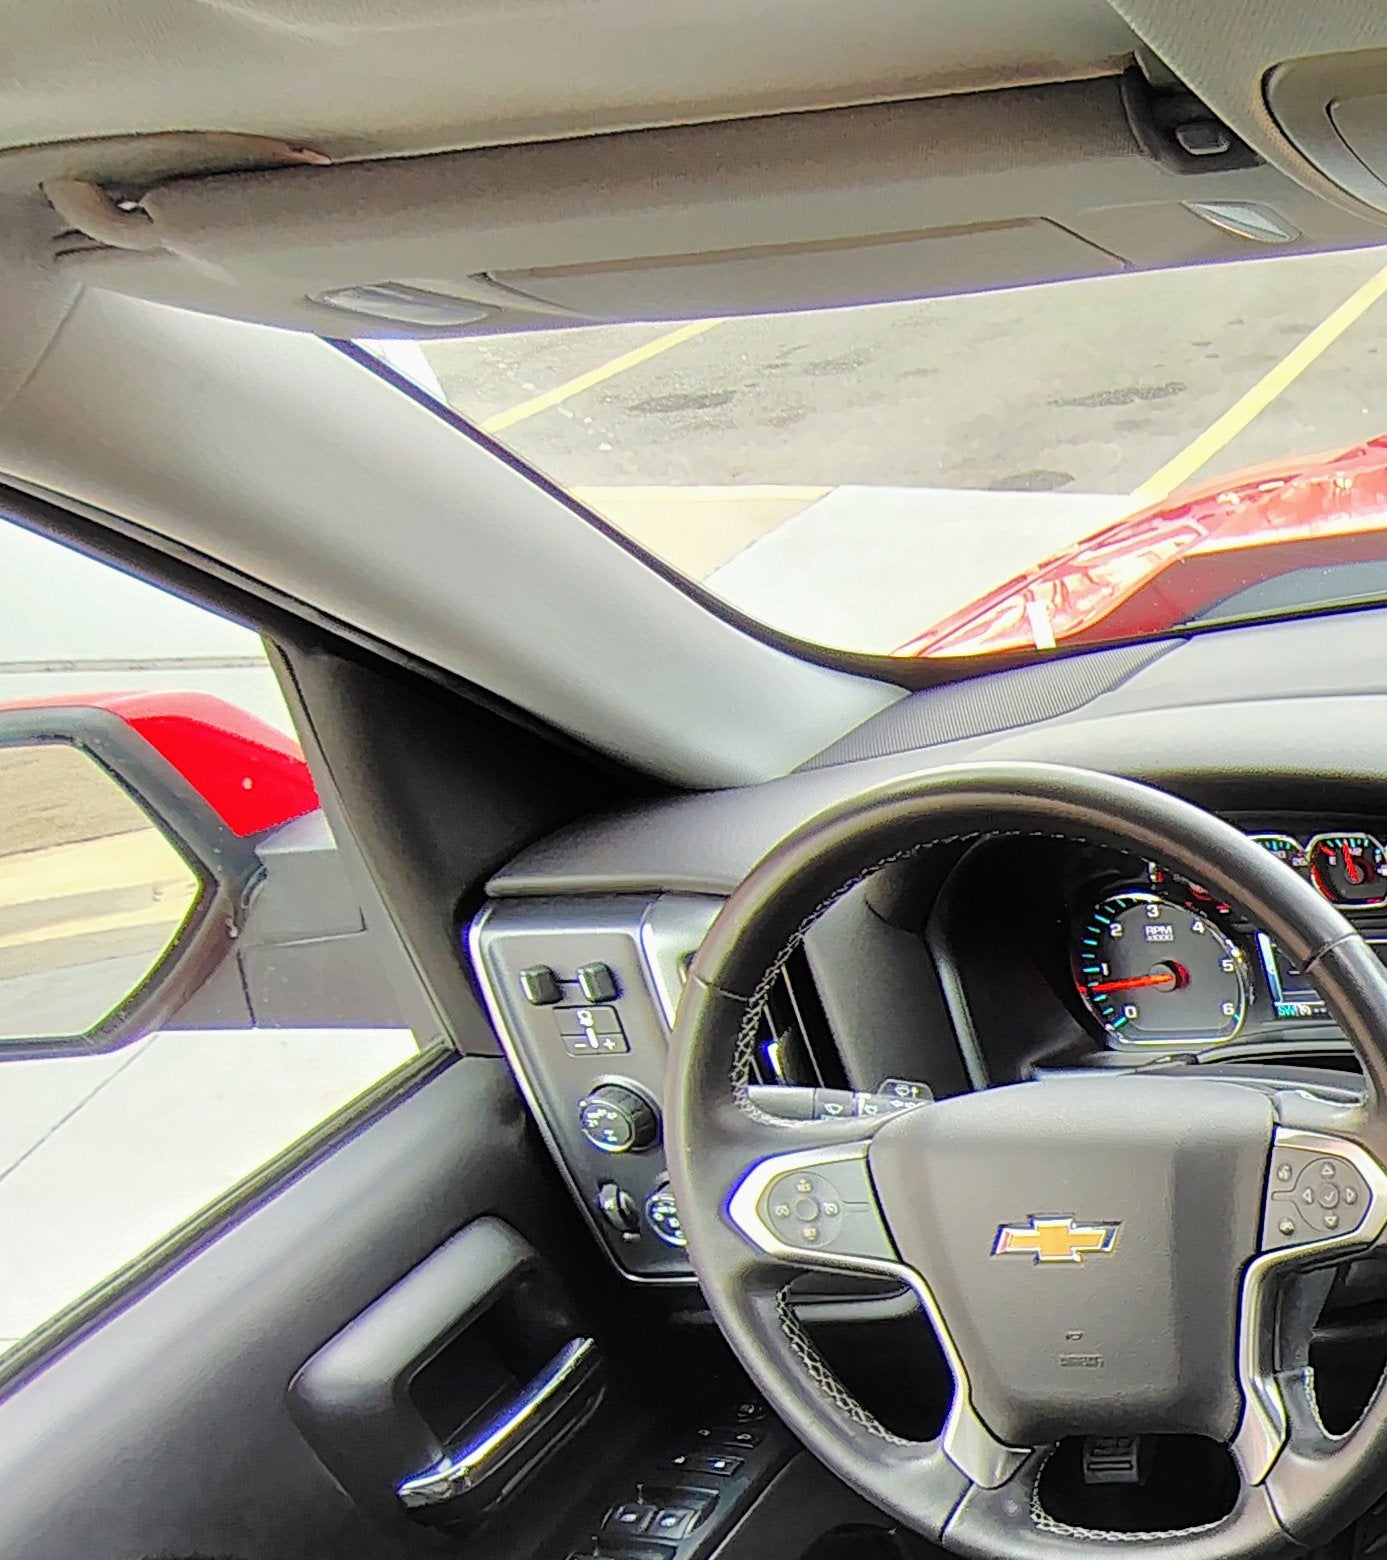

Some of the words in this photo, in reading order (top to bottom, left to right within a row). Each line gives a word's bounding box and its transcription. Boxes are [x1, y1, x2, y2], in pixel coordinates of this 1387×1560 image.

[1146, 904, 1160, 918] 3
[1109, 923, 1123, 938] 2
[1145, 925, 1174, 935] RPM
[1192, 922, 1205, 934] 4
[1101, 962, 1109, 977] 1
[1221, 959, 1234, 973] 5
[1124, 1006, 1137, 1019] 0
[1221, 1002, 1235, 1016] 6
